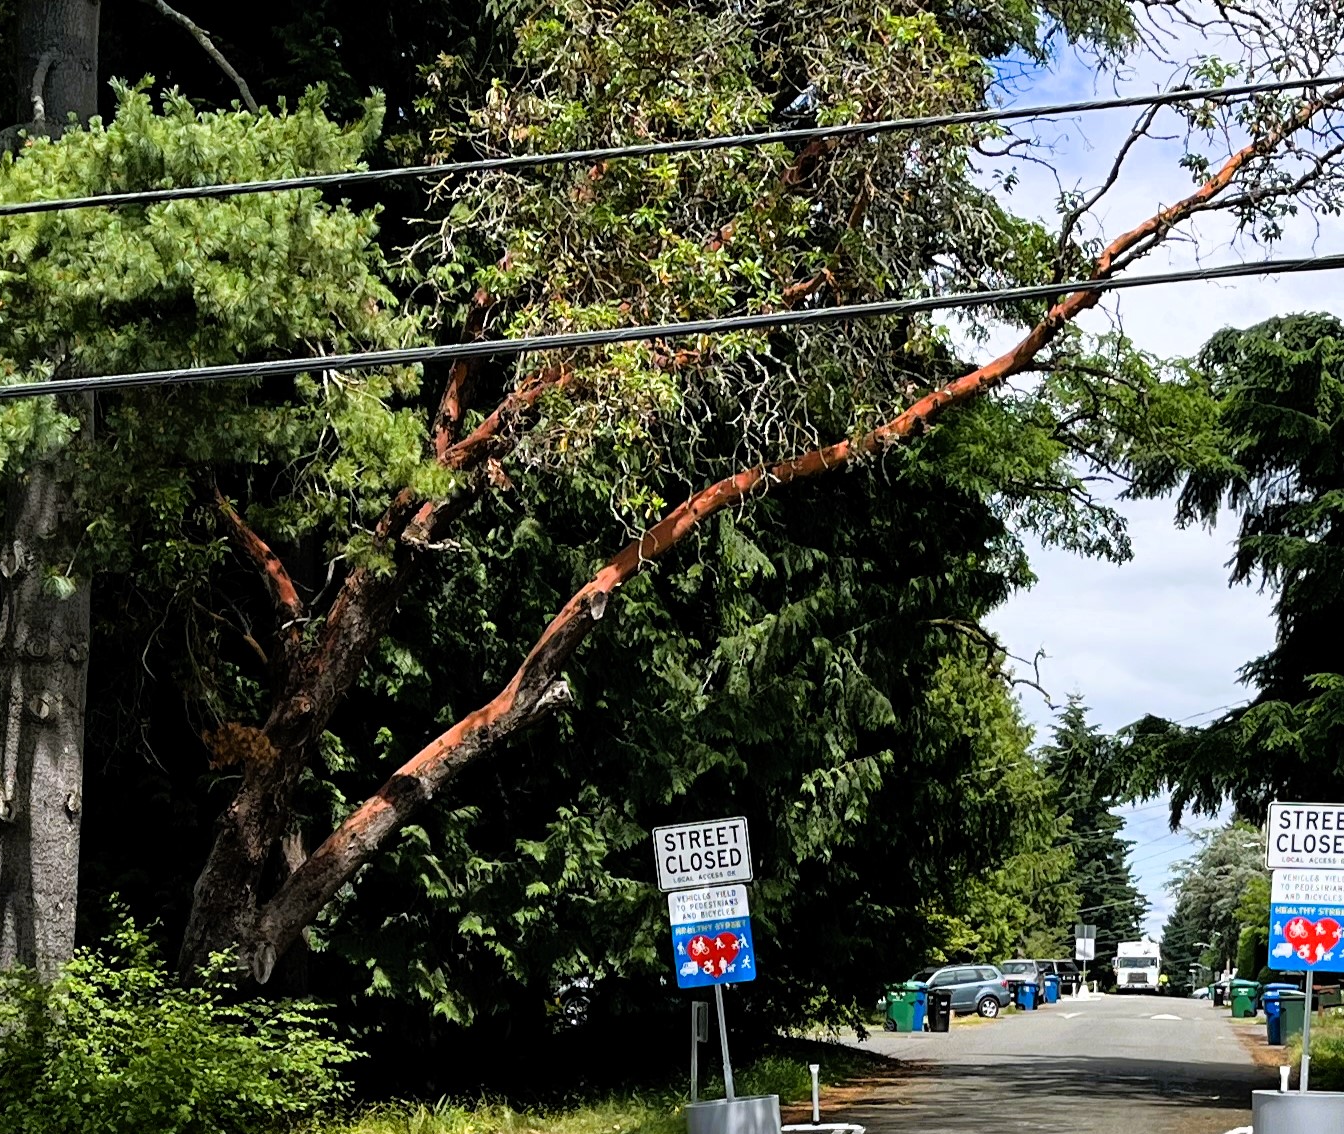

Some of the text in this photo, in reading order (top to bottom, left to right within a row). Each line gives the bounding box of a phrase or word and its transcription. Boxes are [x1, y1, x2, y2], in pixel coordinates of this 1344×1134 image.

[664, 824, 740, 852] STREET
[665, 848, 742, 874] CLOSED
[673, 875, 695, 884] LOCAL
[698, 871, 724, 880] ACCESS
